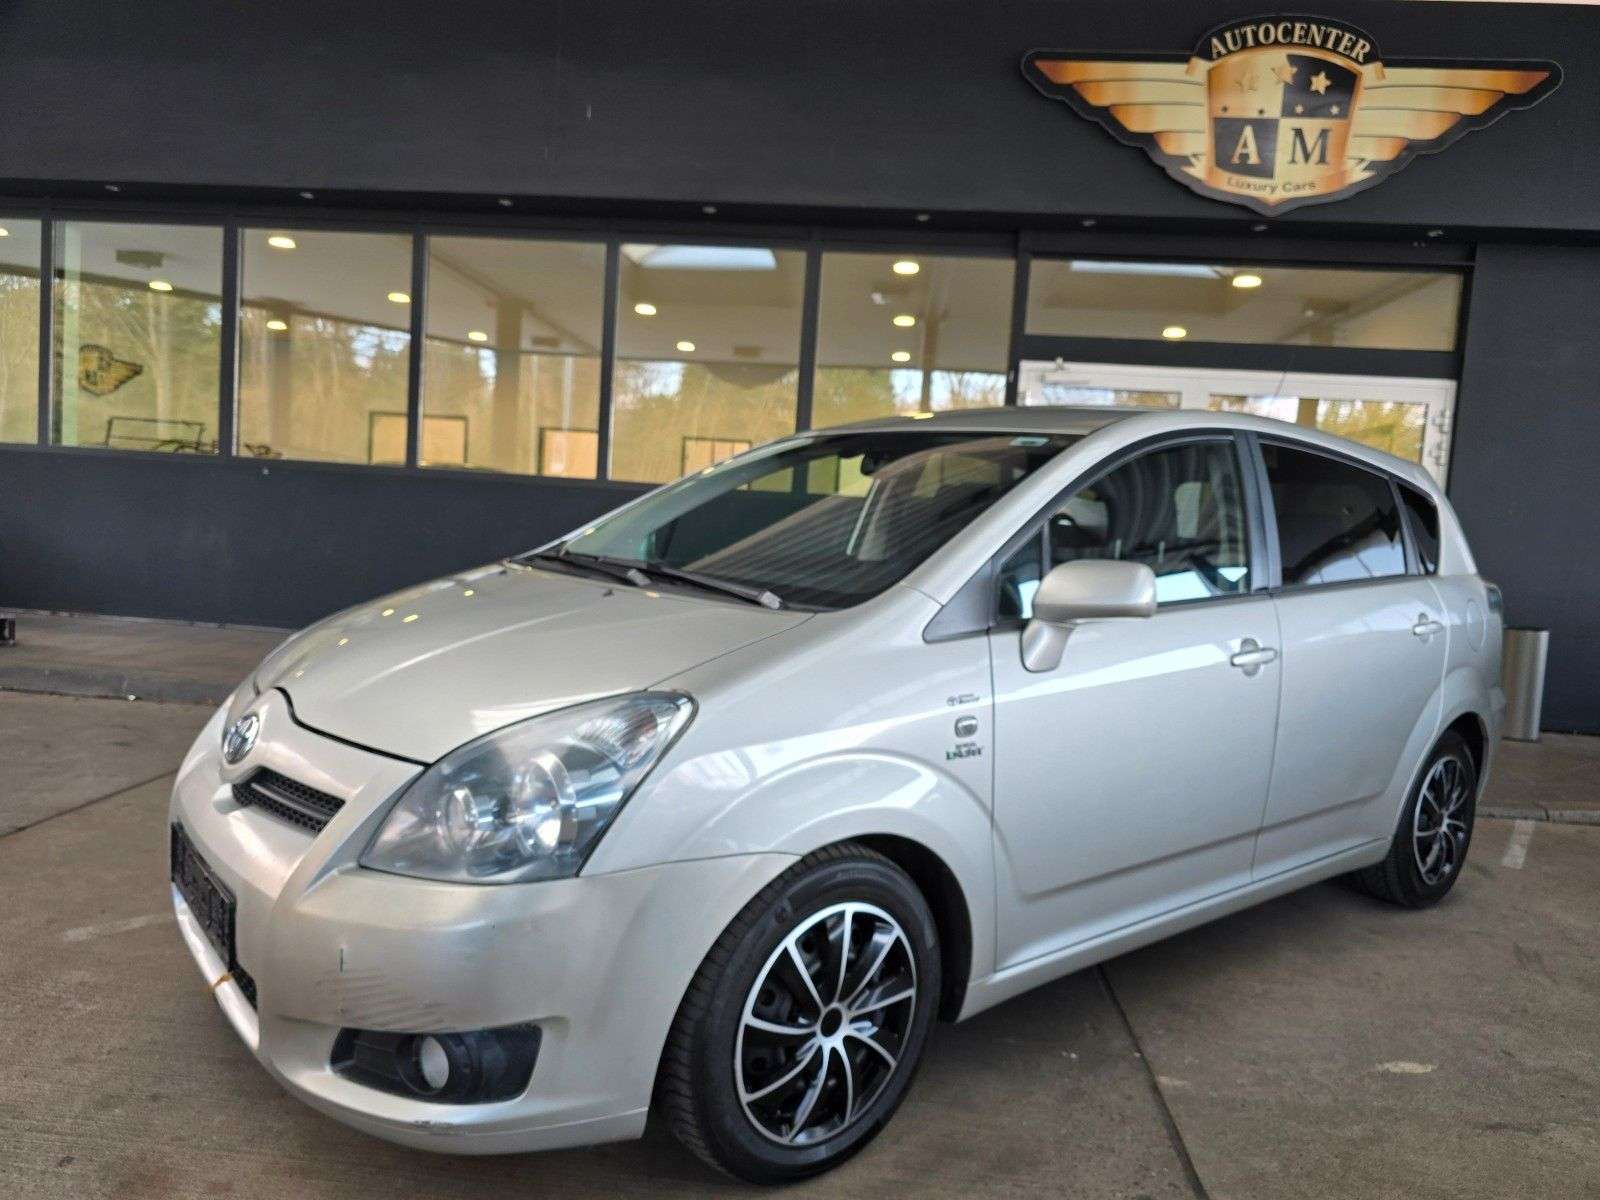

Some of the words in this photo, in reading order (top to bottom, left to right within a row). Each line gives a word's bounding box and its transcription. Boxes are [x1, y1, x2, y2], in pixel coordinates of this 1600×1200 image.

[1210, 22, 1371, 63] AUTOCENTER
[1227, 177, 1278, 193] Luxury
[1282, 181, 1316, 192] Cars
